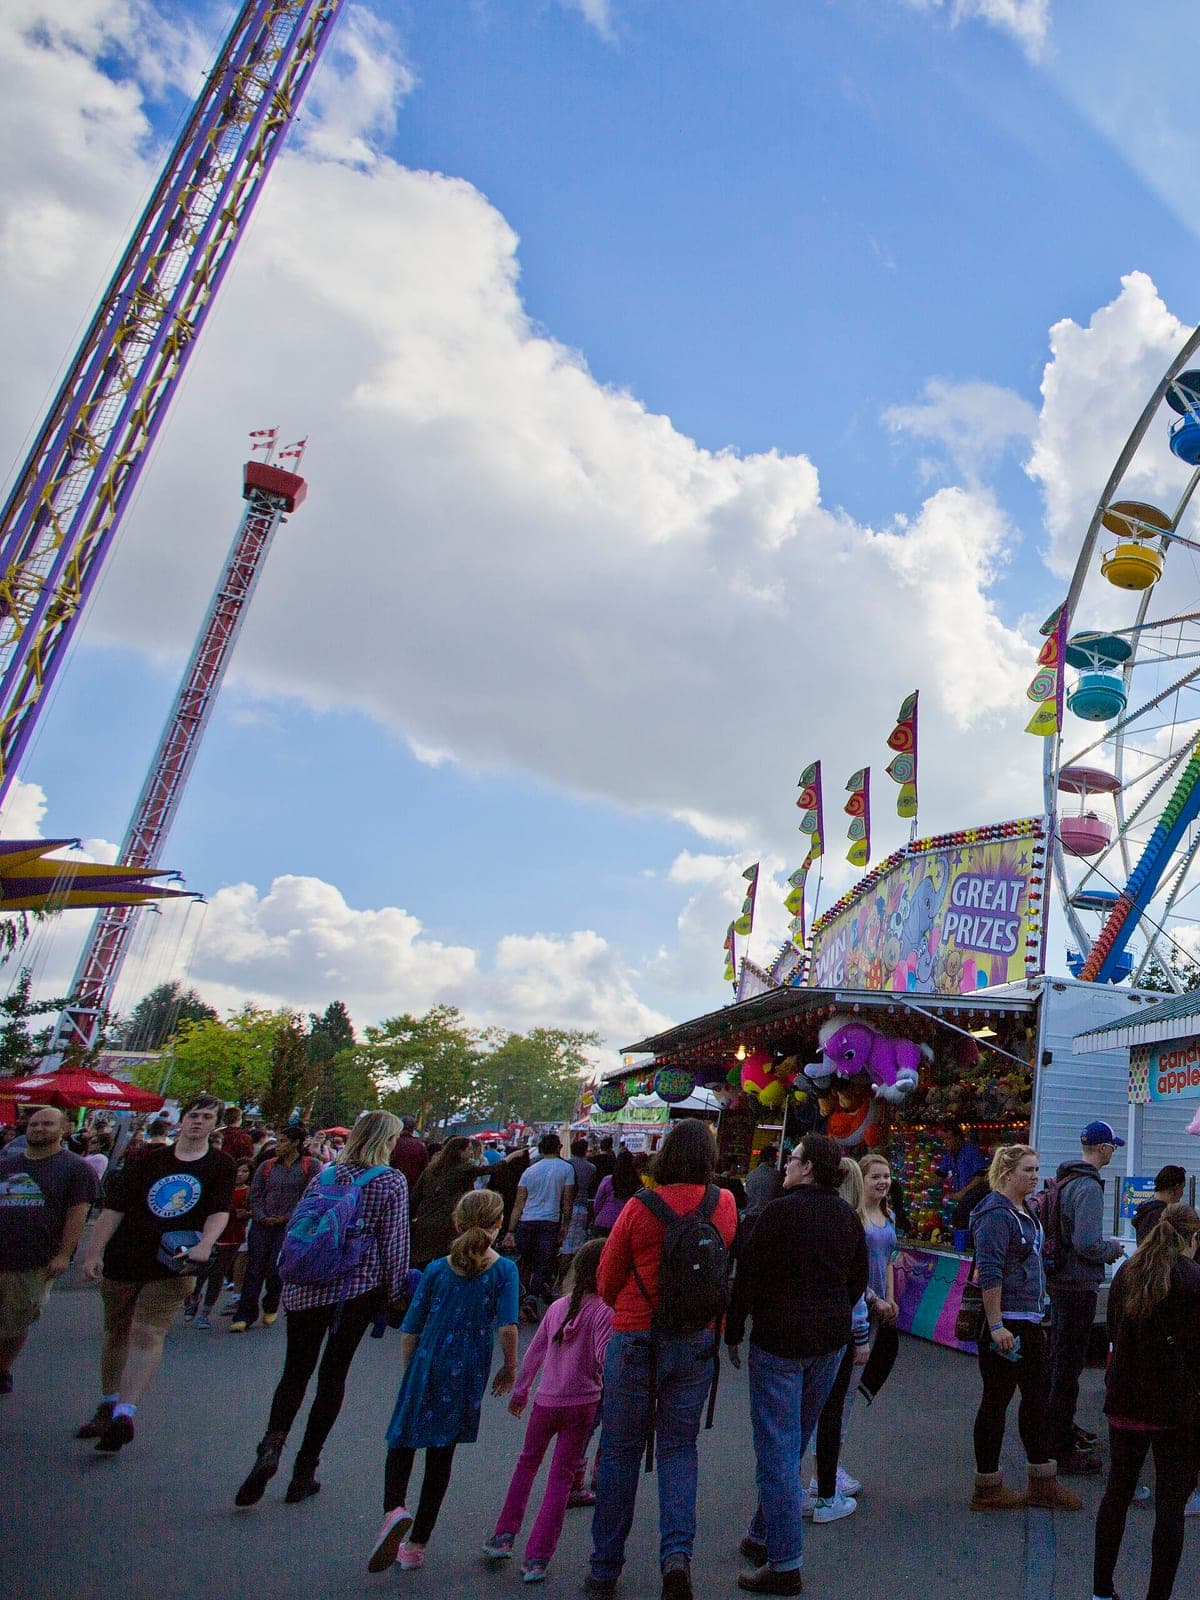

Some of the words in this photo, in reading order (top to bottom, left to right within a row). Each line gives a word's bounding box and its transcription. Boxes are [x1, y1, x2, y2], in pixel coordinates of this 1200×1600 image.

[952, 878, 1025, 913] GREAT
[943, 912, 1019, 953] PRIZES
[816, 929, 846, 981] WIN
[0, 1199, 45, 1207] UIKSILVER
